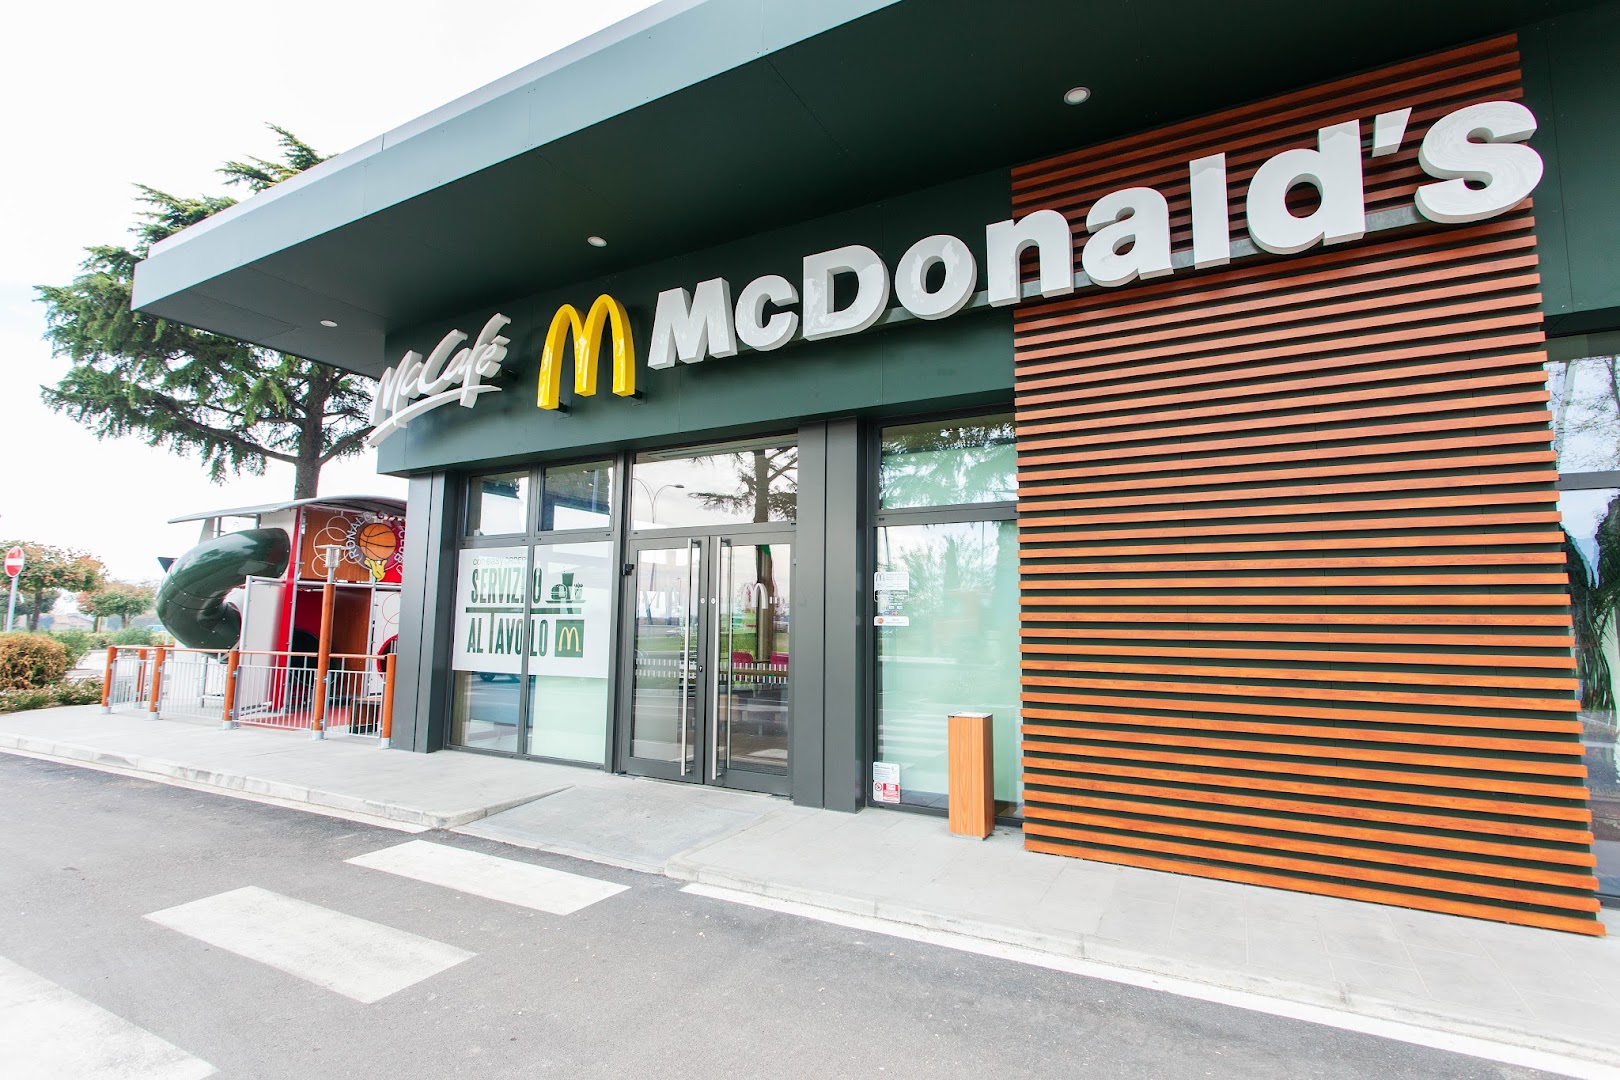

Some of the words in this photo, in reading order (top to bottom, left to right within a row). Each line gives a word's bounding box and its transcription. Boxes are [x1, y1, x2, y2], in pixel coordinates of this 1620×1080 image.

[648, 101, 1544, 369] McDonald's
[369, 312, 512, 430] McCafé
[345, 511, 373, 559] RONALD
[471, 567, 542, 604] SERVIZIO
[466, 617, 483, 654] AL
[488, 612, 549, 657] TAVOLO
